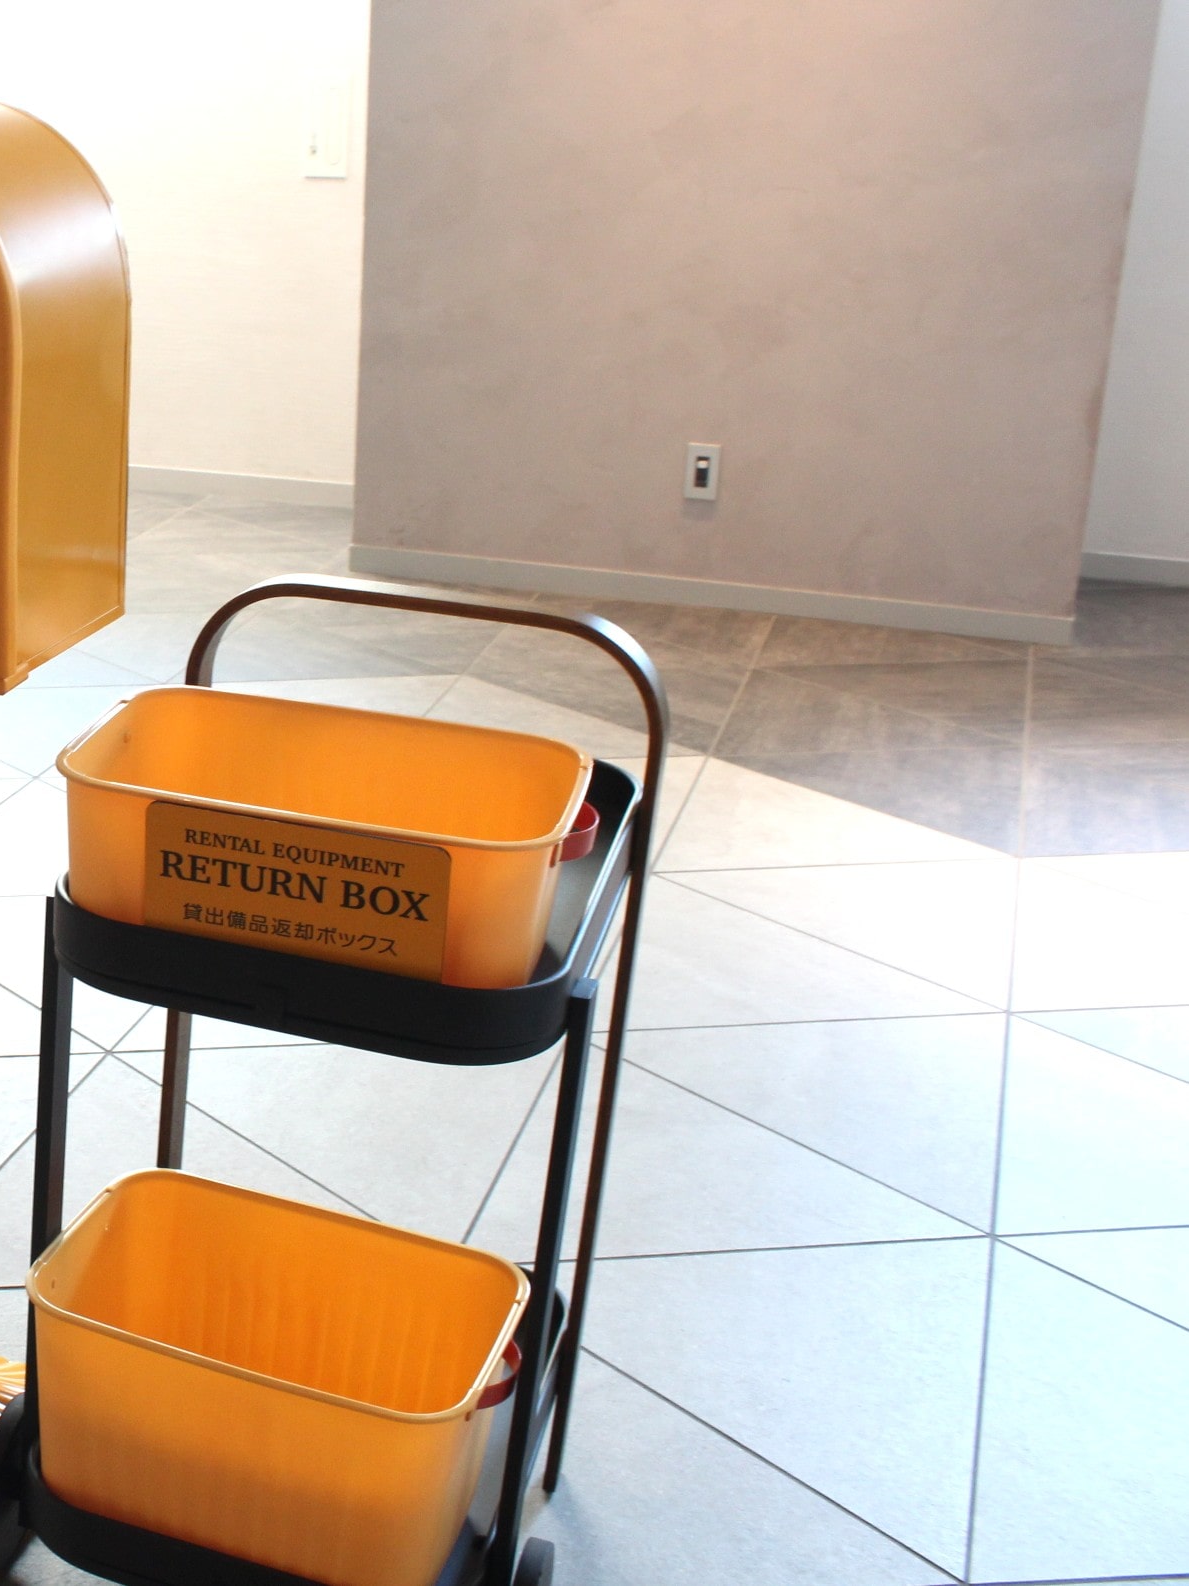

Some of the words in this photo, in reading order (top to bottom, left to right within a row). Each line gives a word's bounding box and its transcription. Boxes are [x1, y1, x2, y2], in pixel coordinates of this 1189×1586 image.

[184, 828, 265, 855] RENTAL
[272, 843, 405, 878] EQUIPMENT
[159, 849, 328, 904] RETURN
[340, 880, 431, 922] BOX
[182, 902, 398, 957] 貸出備品返却ボックス
